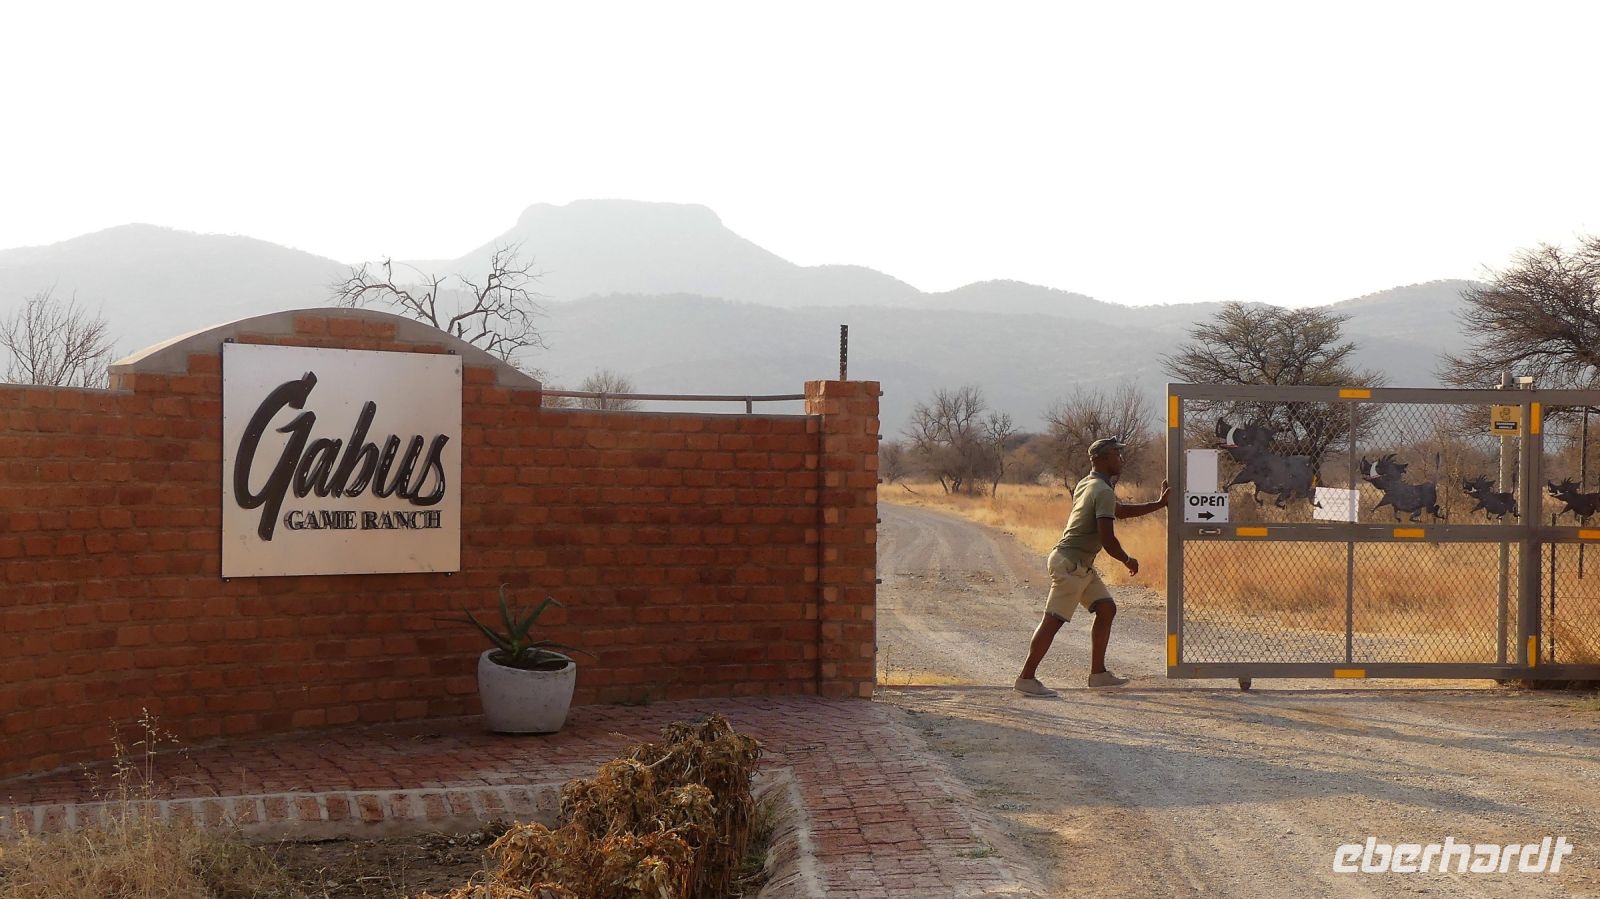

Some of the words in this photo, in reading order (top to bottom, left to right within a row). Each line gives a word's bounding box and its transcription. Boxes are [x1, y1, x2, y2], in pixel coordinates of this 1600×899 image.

[233, 371, 449, 541] Gabus
[1189, 495, 1225, 507] OPEN
[284, 510, 357, 530] GAME
[360, 509, 442, 530] RANCH
